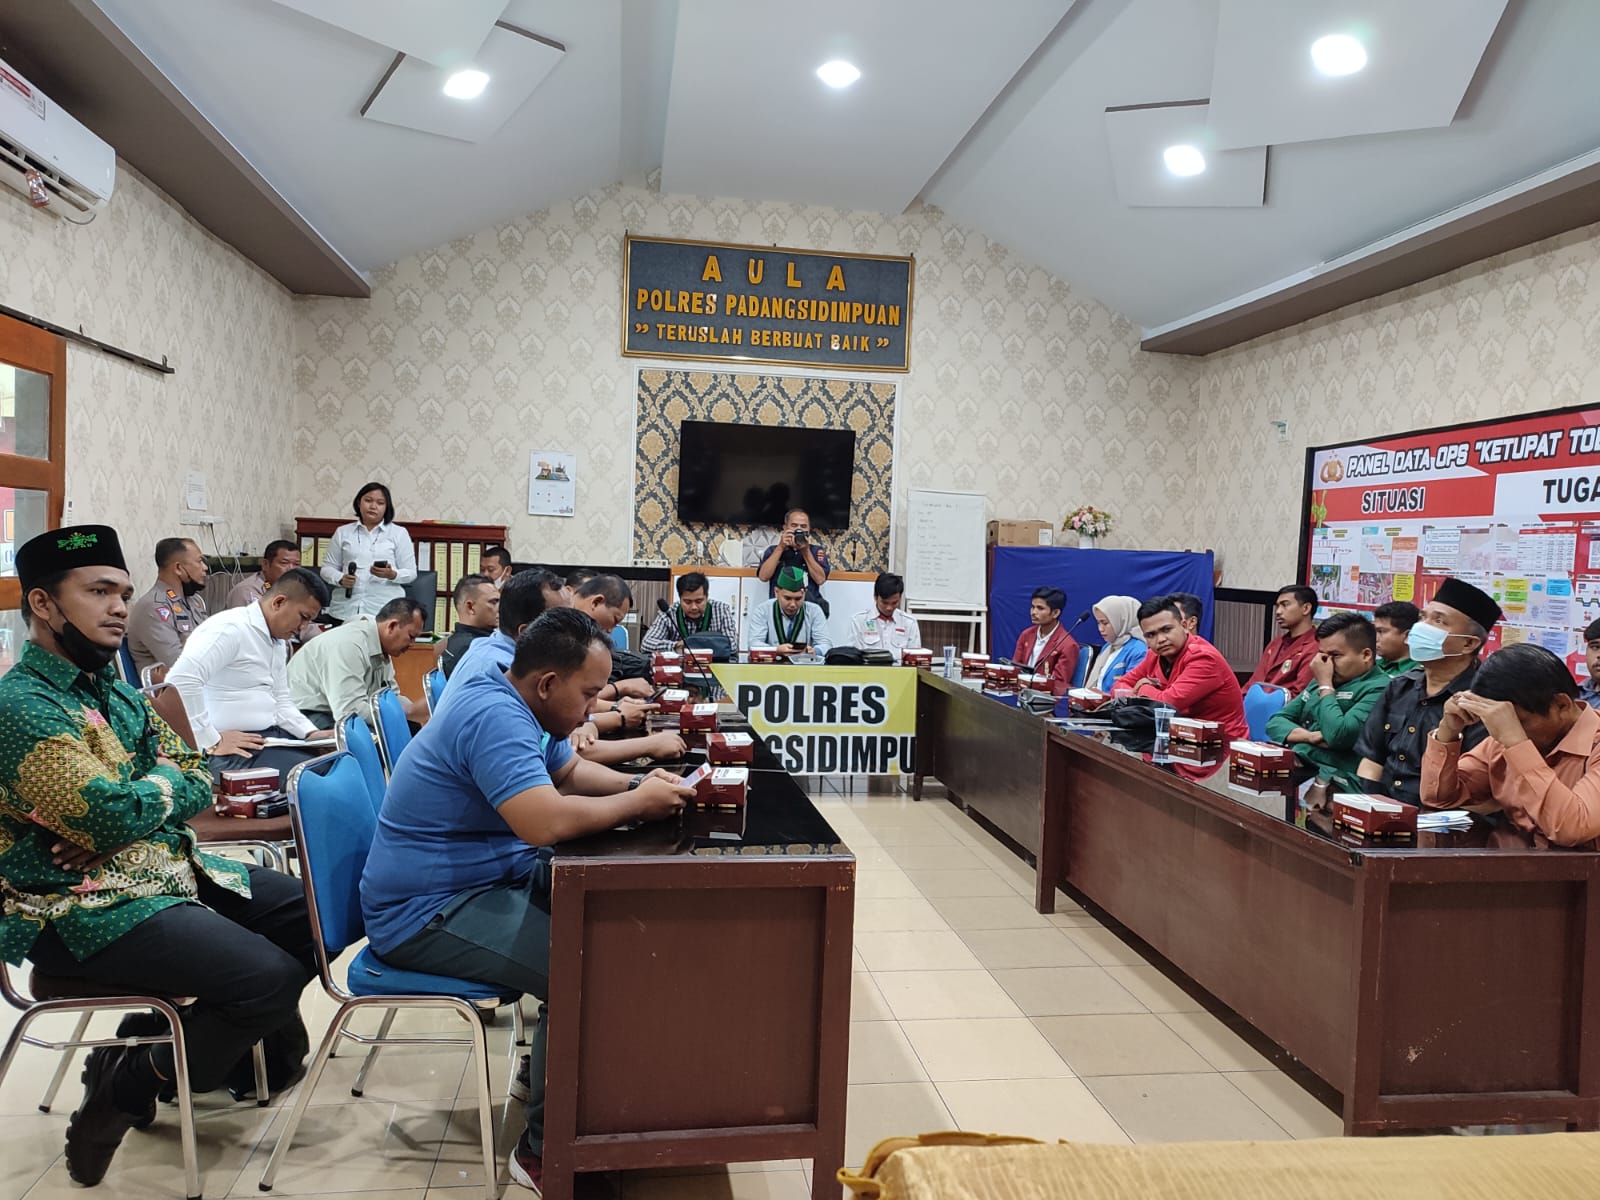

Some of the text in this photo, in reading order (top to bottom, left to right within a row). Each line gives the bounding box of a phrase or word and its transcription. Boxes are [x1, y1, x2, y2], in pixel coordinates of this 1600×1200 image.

[636, 288, 900, 326] POLRES PADANGSIDIMPUAN
[656, 323, 742, 345] TERUSLAH
[751, 329, 823, 349] BERBUAT
[831, 336, 870, 352] BAIK
[1347, 452, 1390, 477] PANEL
[1392, 448, 1431, 473] DATA
[1434, 442, 1470, 468] OPS
[1362, 488, 1425, 513] SITUASI
[738, 684, 886, 724] POLRES
